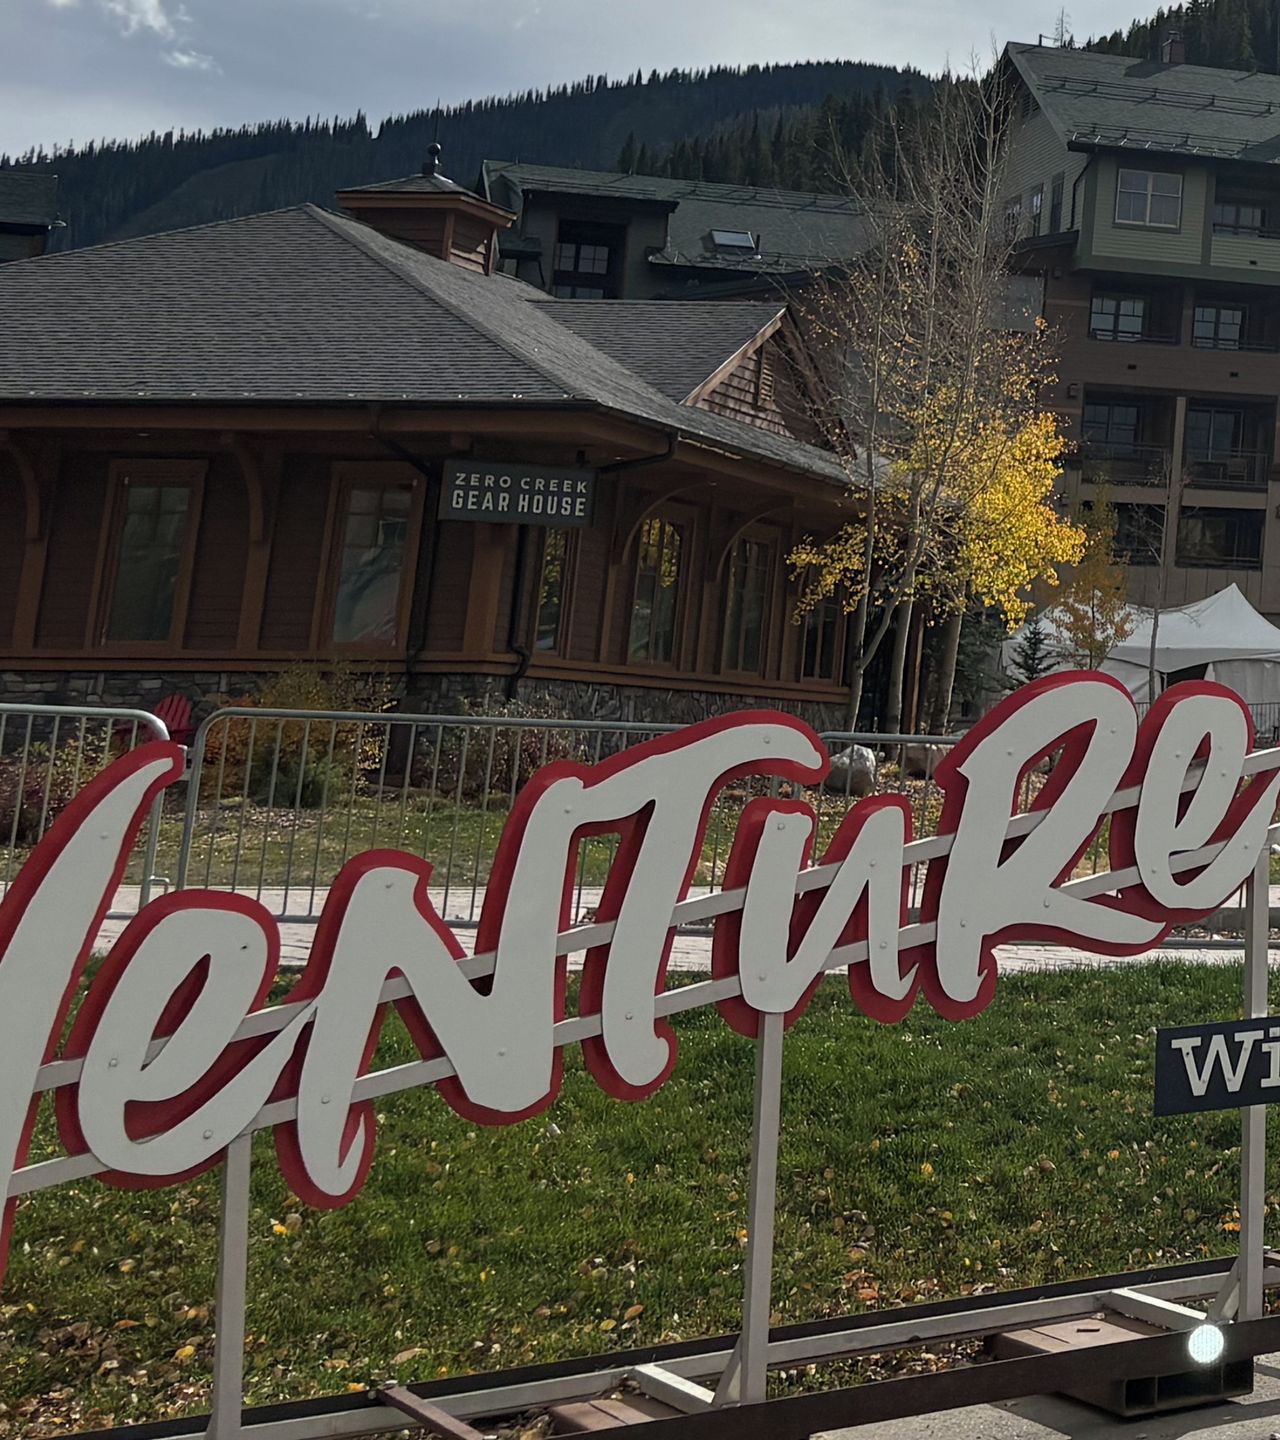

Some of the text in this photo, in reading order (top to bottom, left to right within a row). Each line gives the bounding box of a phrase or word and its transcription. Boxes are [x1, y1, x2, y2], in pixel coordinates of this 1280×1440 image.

[455, 472, 588, 494] ZERO CREEK
[452, 489, 587, 517] GEAR HOUSE
